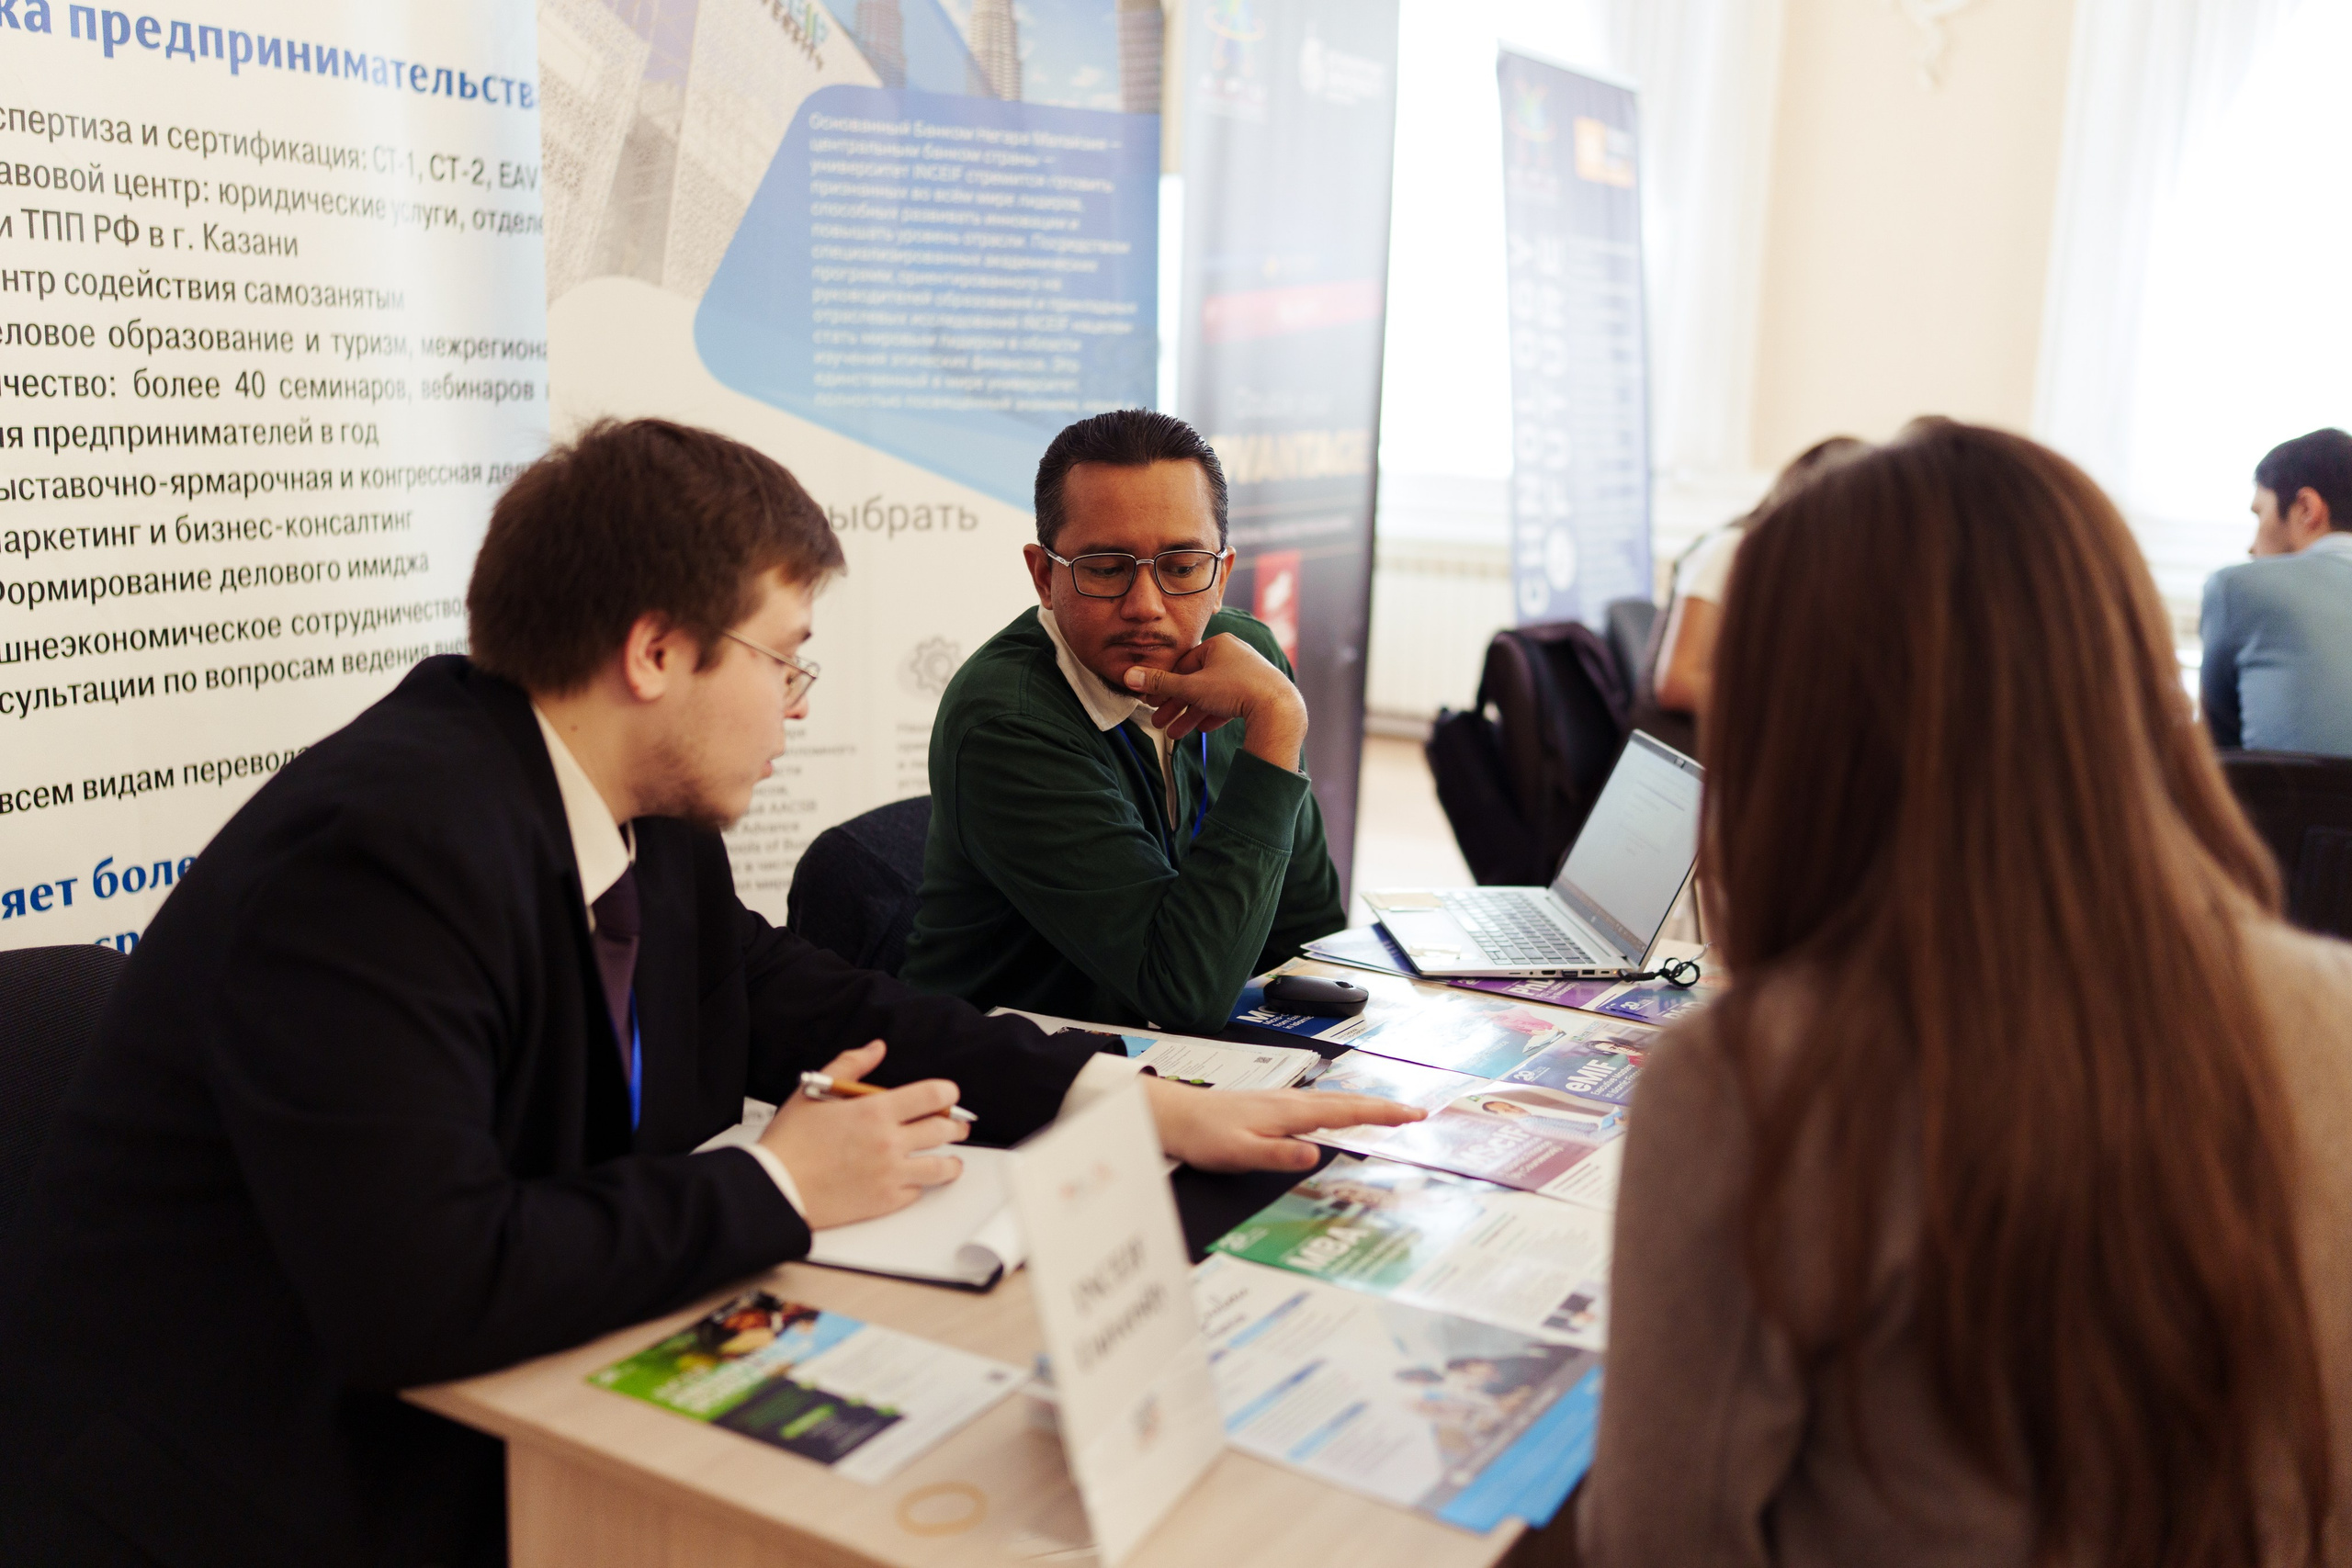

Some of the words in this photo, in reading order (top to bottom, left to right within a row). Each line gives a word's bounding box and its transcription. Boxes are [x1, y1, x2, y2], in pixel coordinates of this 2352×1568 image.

[69, 4, 538, 109] предпринимательств
[141, 122, 158, 146] и
[168, 127, 368, 172] сертификация:
[0, 160, 105, 194] авовой
[114, 172, 209, 203] центр:
[219, 184, 386, 220] юридические
[390, 199, 465, 233] услуги,
[21, 208, 85, 243] ТПП
[94, 213, 139, 246] РФ
[149, 225, 164, 248] в
[174, 226, 194, 250] г.
[203, 223, 299, 257] Казани
[2, 269, 55, 300] нтр
[64, 269, 236, 303] содействия
[244, 284, 405, 312] самозанятым
[0, 322, 96, 348] ловое
[108, 318, 294, 355] образование
[306, 332, 321, 354] и
[331, 332, 413, 362] туризм,
[0, 373, 116, 399] чество:
[134, 367, 220, 399] более
[234, 370, 266, 398] 40
[279, 376, 413, 405] семинаров,
[421, 373, 535, 407] вебинаров
[0, 425, 24, 449] я
[34, 417, 313, 456] предпринимателей
[322, 423, 334, 445] в
[341, 423, 379, 447] год
[0, 466, 333, 502] ыставочно-ярмарочная
[341, 469, 354, 490] и
[361, 462, 482, 493] конгрессная
[0, 523, 141, 560] аркетинг
[150, 523, 166, 546] и
[175, 509, 413, 546] бизнес-консалтинг
[0, 564, 212, 611] ормирование
[220, 558, 341, 596] делового
[347, 551, 430, 582] имиджа
[0, 615, 282, 664] шнеэкономическое
[0, 676, 155, 719] сультации
[164, 669, 198, 697] по
[205, 657, 334, 692] вопросам
[342, 643, 429, 678] ведения
[0, 781, 74, 816] всем
[83, 768, 175, 800] видам
[183, 747, 310, 788] перевод
[1, 876, 79, 919] яет
[1565, 1059, 1618, 1093] eMIF
